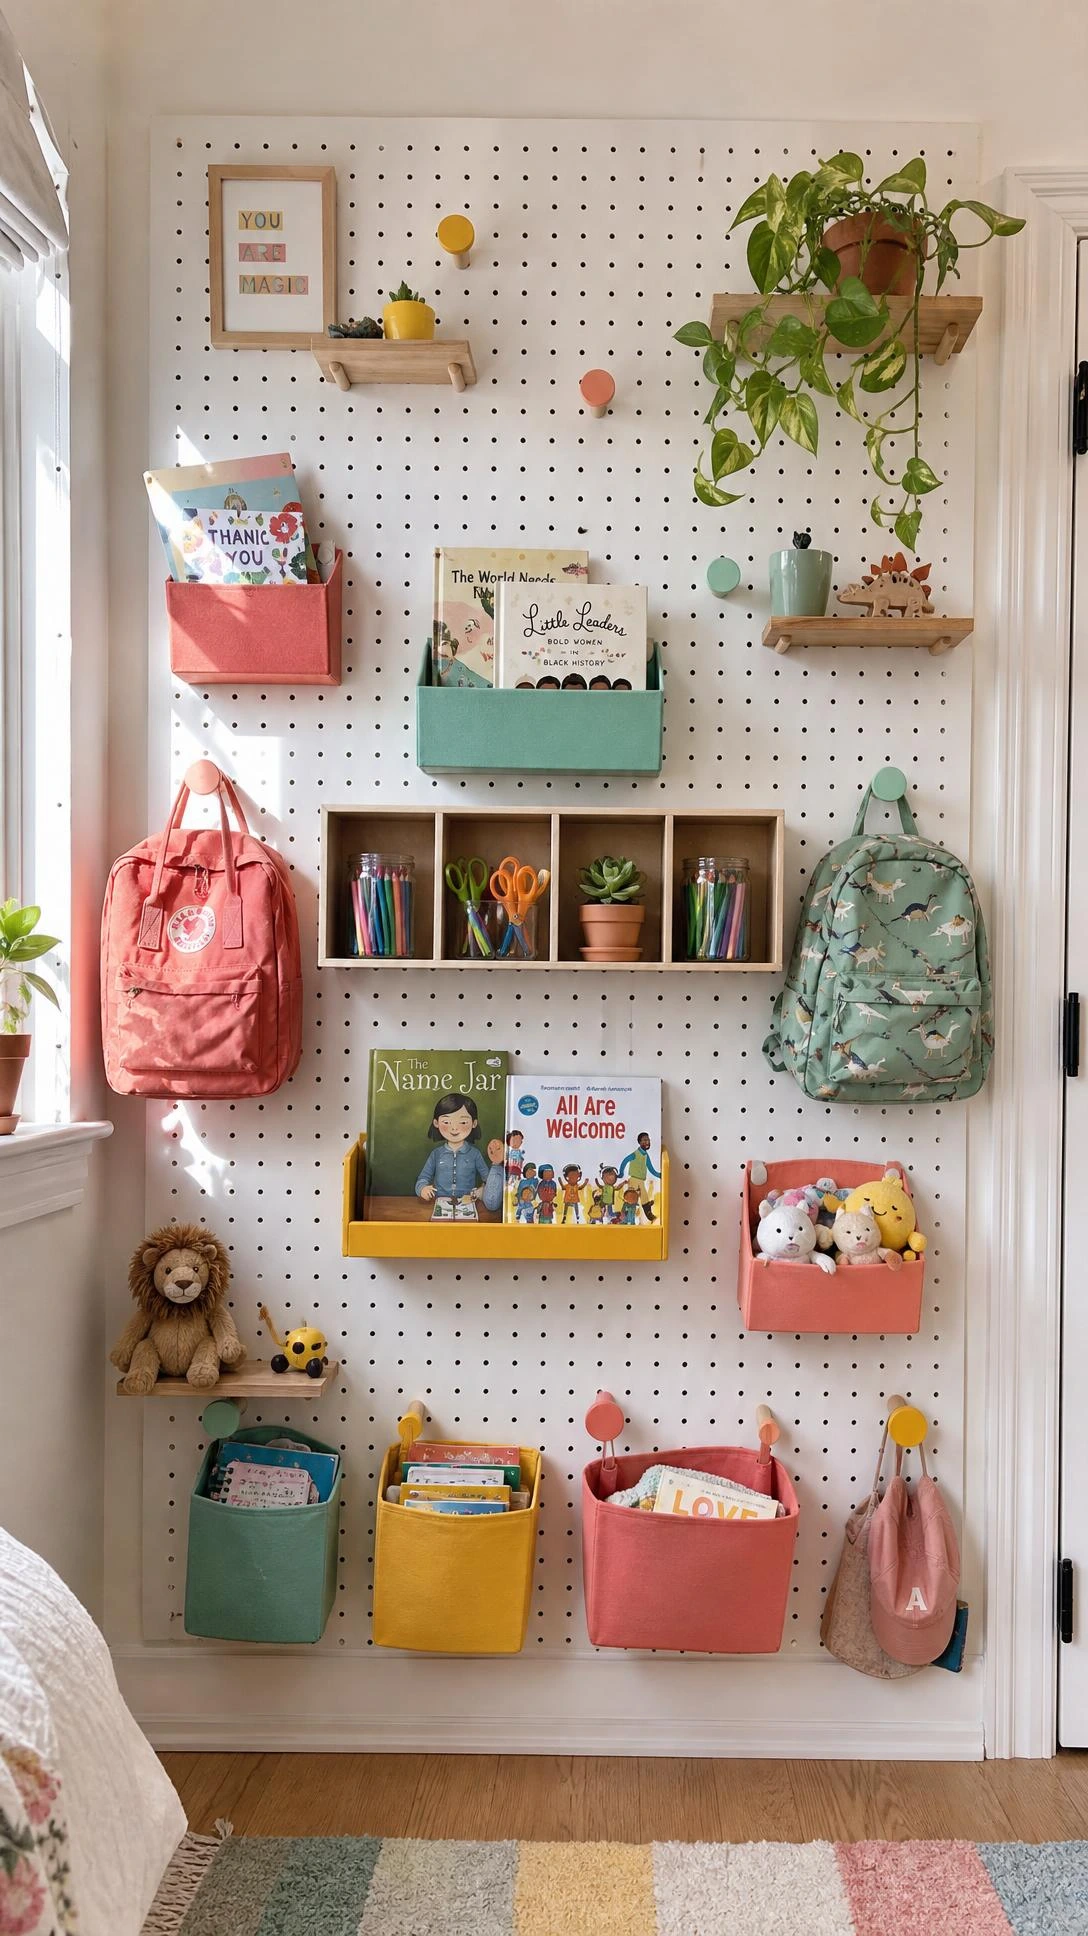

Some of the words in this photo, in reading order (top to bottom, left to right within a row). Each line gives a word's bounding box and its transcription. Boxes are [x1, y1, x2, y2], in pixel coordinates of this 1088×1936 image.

[241, 212, 281, 229] YOU
[241, 244, 282, 261] ARE
[241, 276, 307, 294] MAGIC
[225, 550, 263, 569] YOU
[451, 569, 474, 583] The
[478, 570, 515, 583] World
[522, 603, 570, 637] Little
[572, 601, 627, 636] Leaders
[408, 1058, 429, 1070] The
[376, 1060, 453, 1093] Name
[459, 1061, 502, 1094] Jar
[556, 1095, 578, 1116] All
[584, 1096, 616, 1116] Are
[546, 1118, 626, 1139] Welcome
[905, 1586, 928, 1611] A
